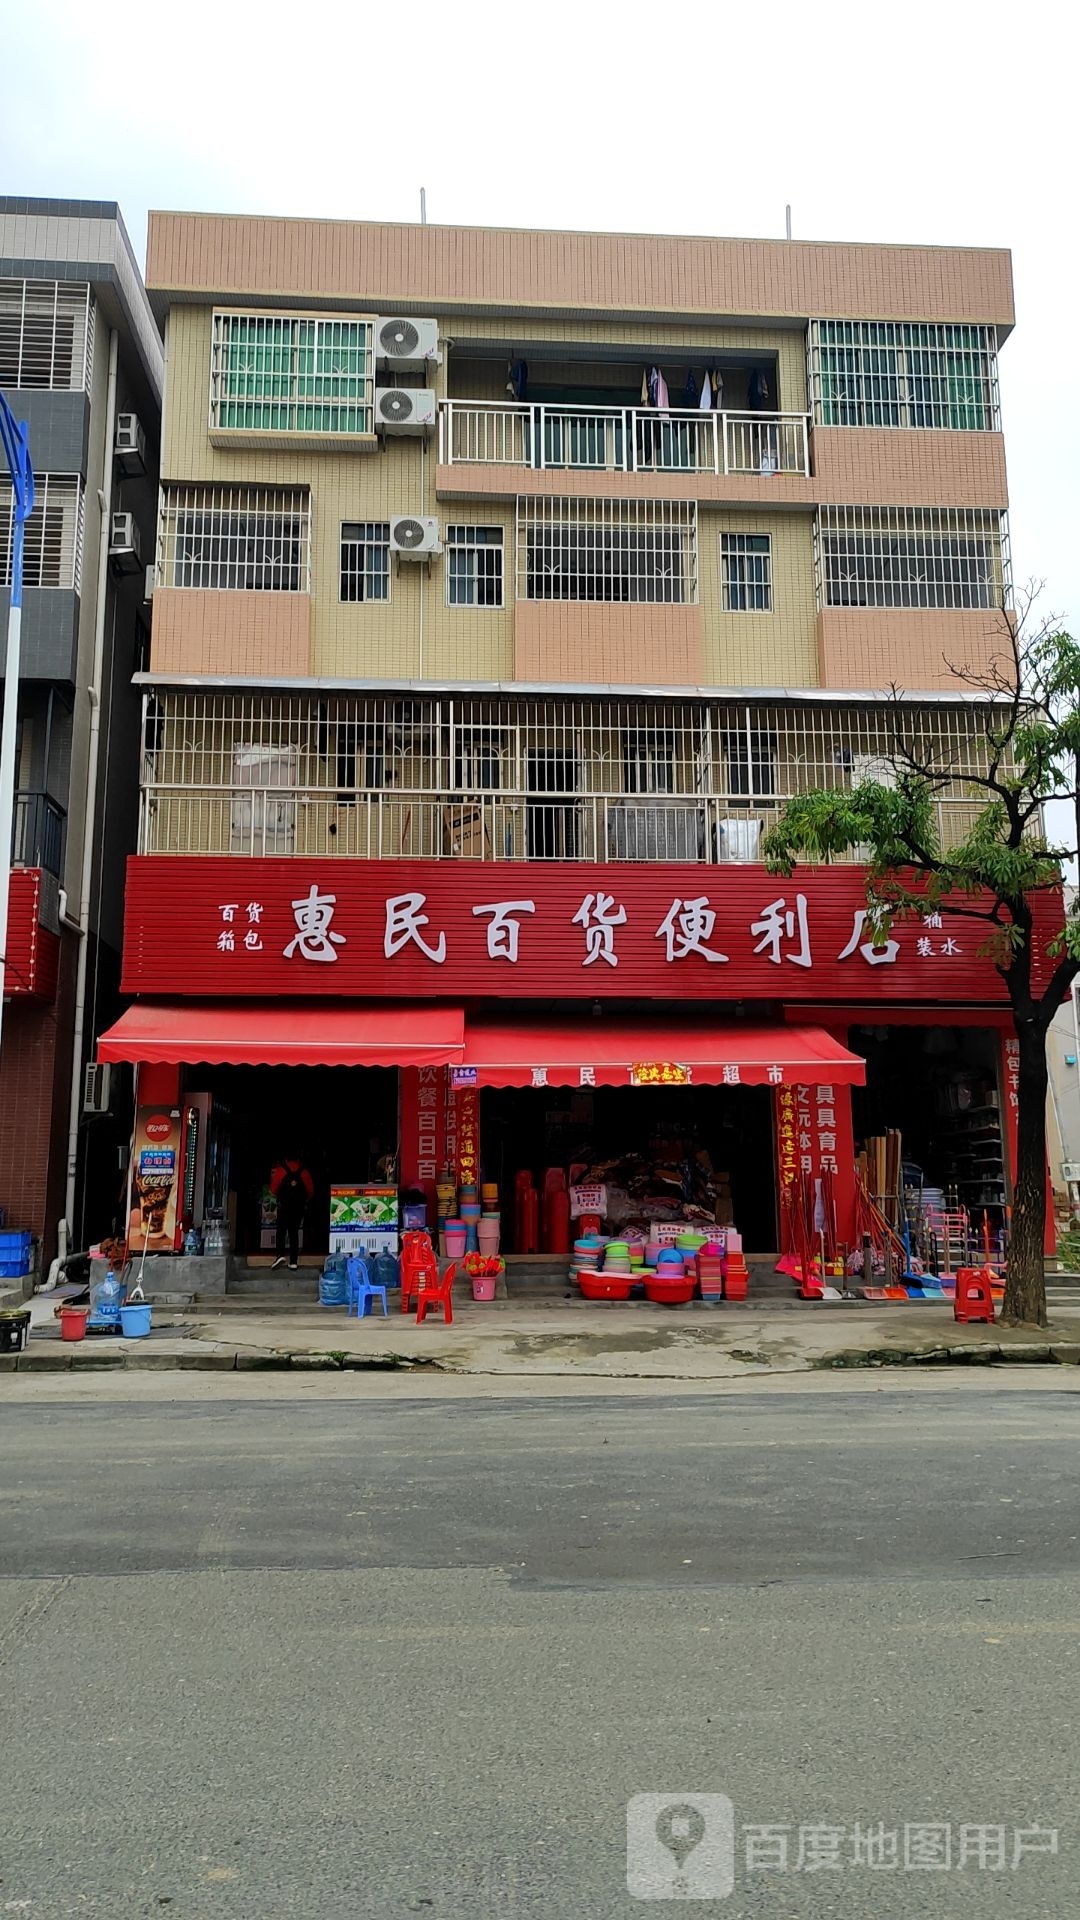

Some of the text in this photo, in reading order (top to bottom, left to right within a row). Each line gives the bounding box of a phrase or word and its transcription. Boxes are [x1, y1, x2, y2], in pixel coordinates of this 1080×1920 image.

[218, 902, 263, 923] 百货
[283, 884, 900, 968] 惠民百货便利店
[217, 931, 263, 952] 箱包
[916, 936, 963, 957] 装水
